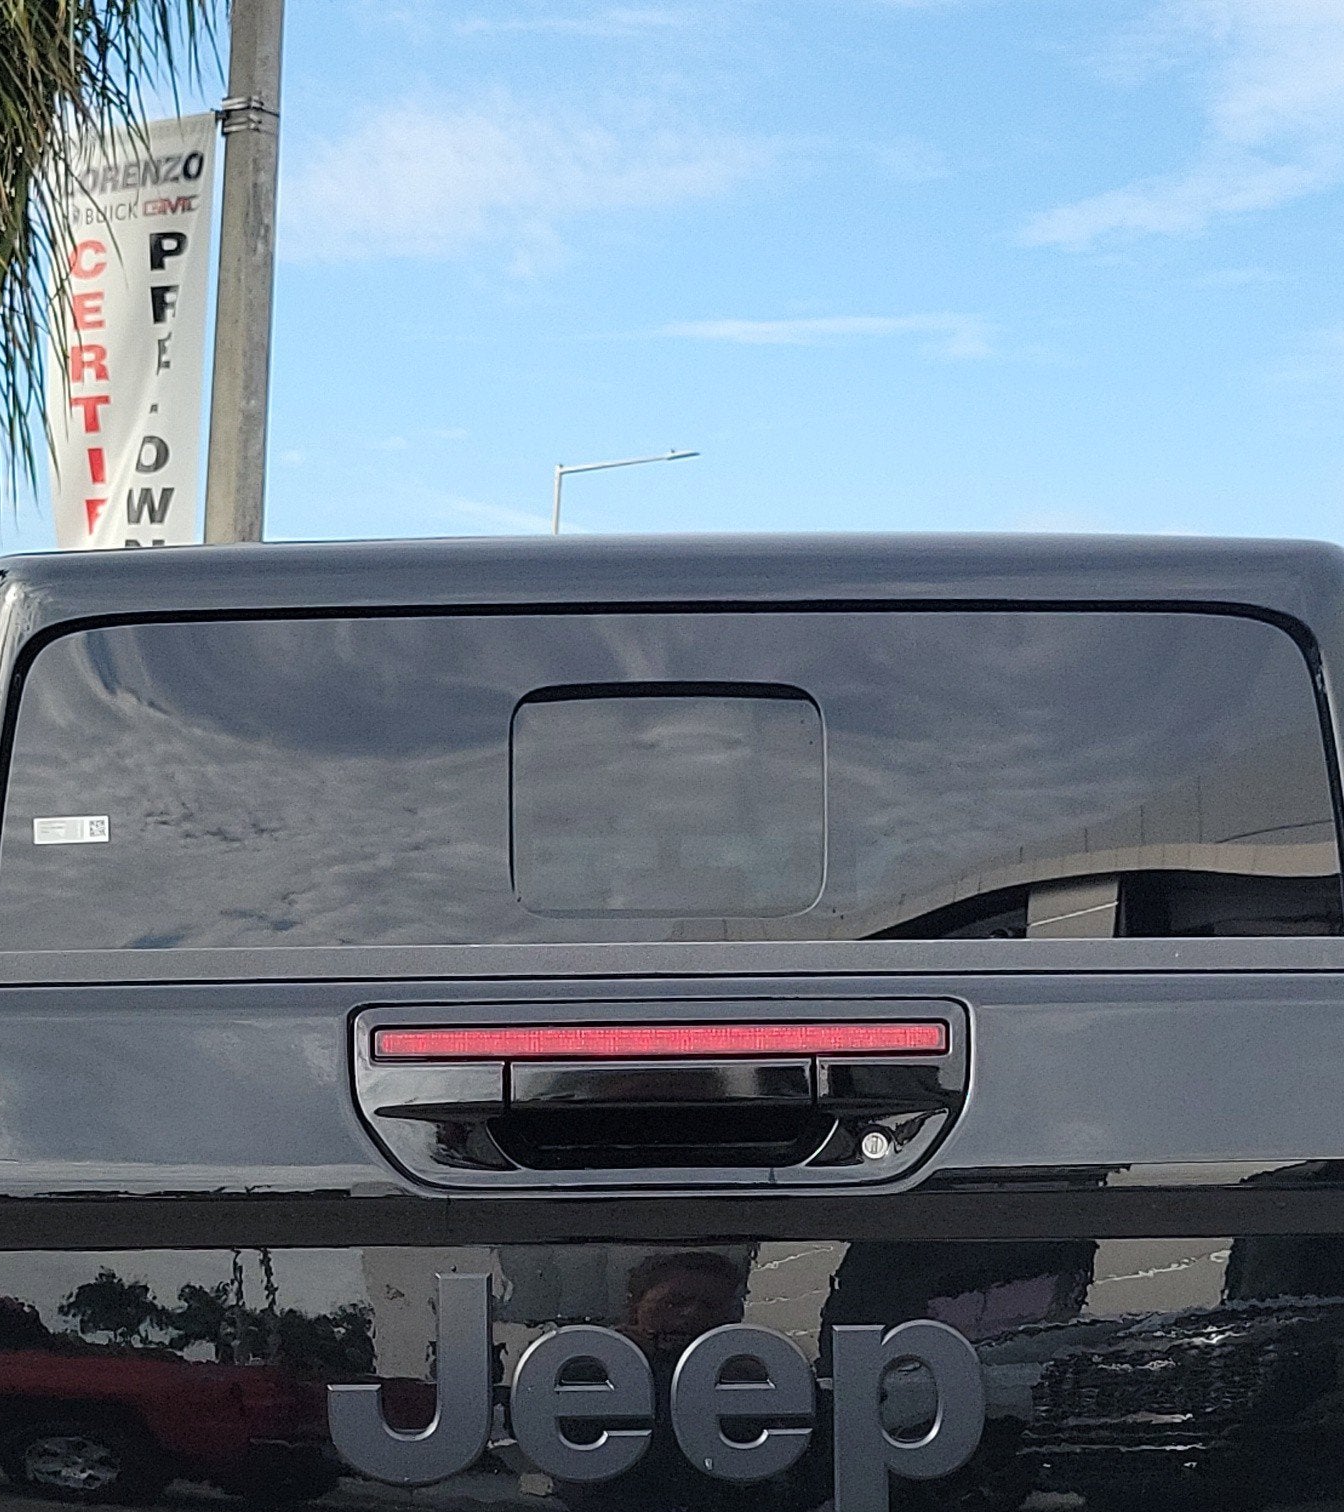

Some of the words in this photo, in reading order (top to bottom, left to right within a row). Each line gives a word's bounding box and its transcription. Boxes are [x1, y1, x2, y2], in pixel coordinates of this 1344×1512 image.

[69, 152, 204, 196] ORENZO
[85, 202, 139, 225] BUICK
[143, 194, 201, 217] GMC
